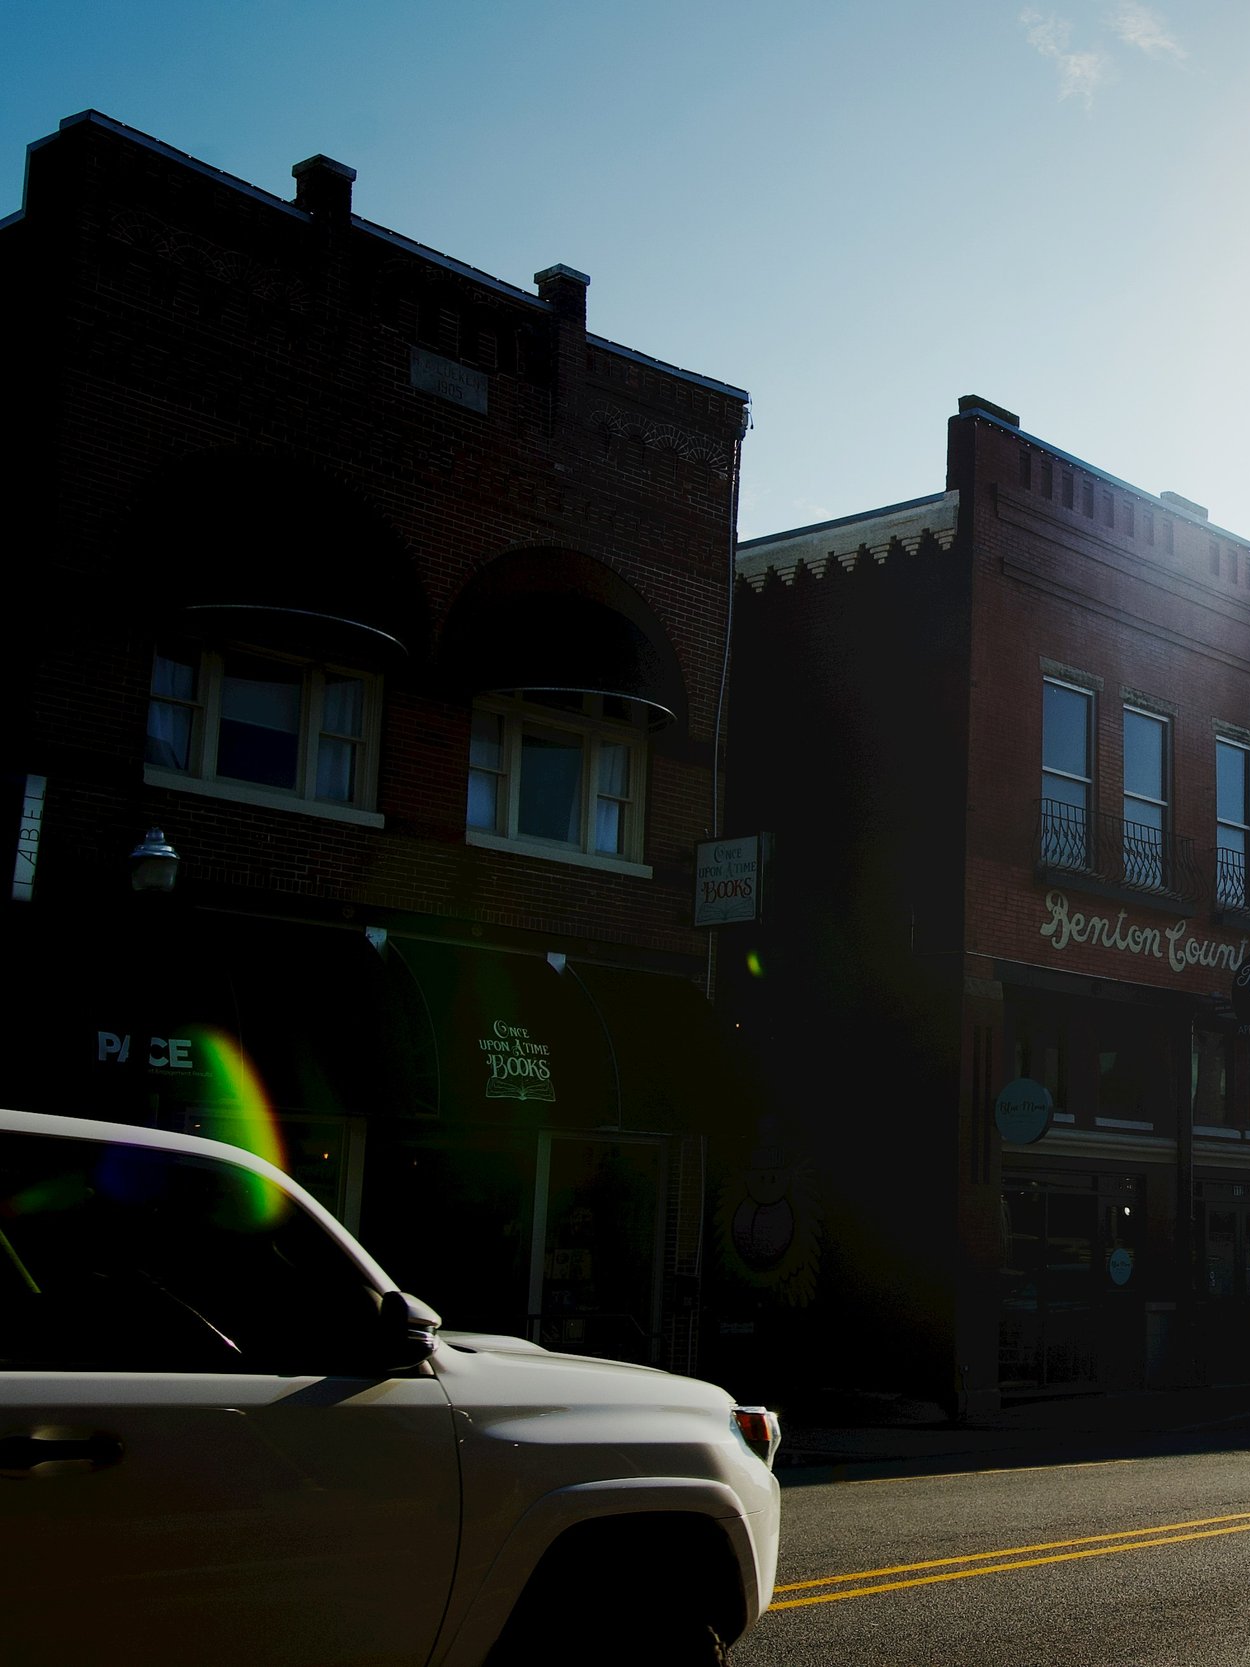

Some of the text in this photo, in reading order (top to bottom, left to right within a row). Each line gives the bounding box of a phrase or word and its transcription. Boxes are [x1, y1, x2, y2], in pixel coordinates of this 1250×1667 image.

[437, 379, 463, 400] 1905
[13, 790, 46, 886] LABEL
[699, 861, 758, 879] UPON A TIME
[701, 877, 753, 904] BOOKS
[1040, 888, 1163, 958] Benton
[1164, 919, 1249, 972] Count
[479, 1038, 550, 1056] UPON A TIME
[486, 1053, 550, 1080] BOOKS
